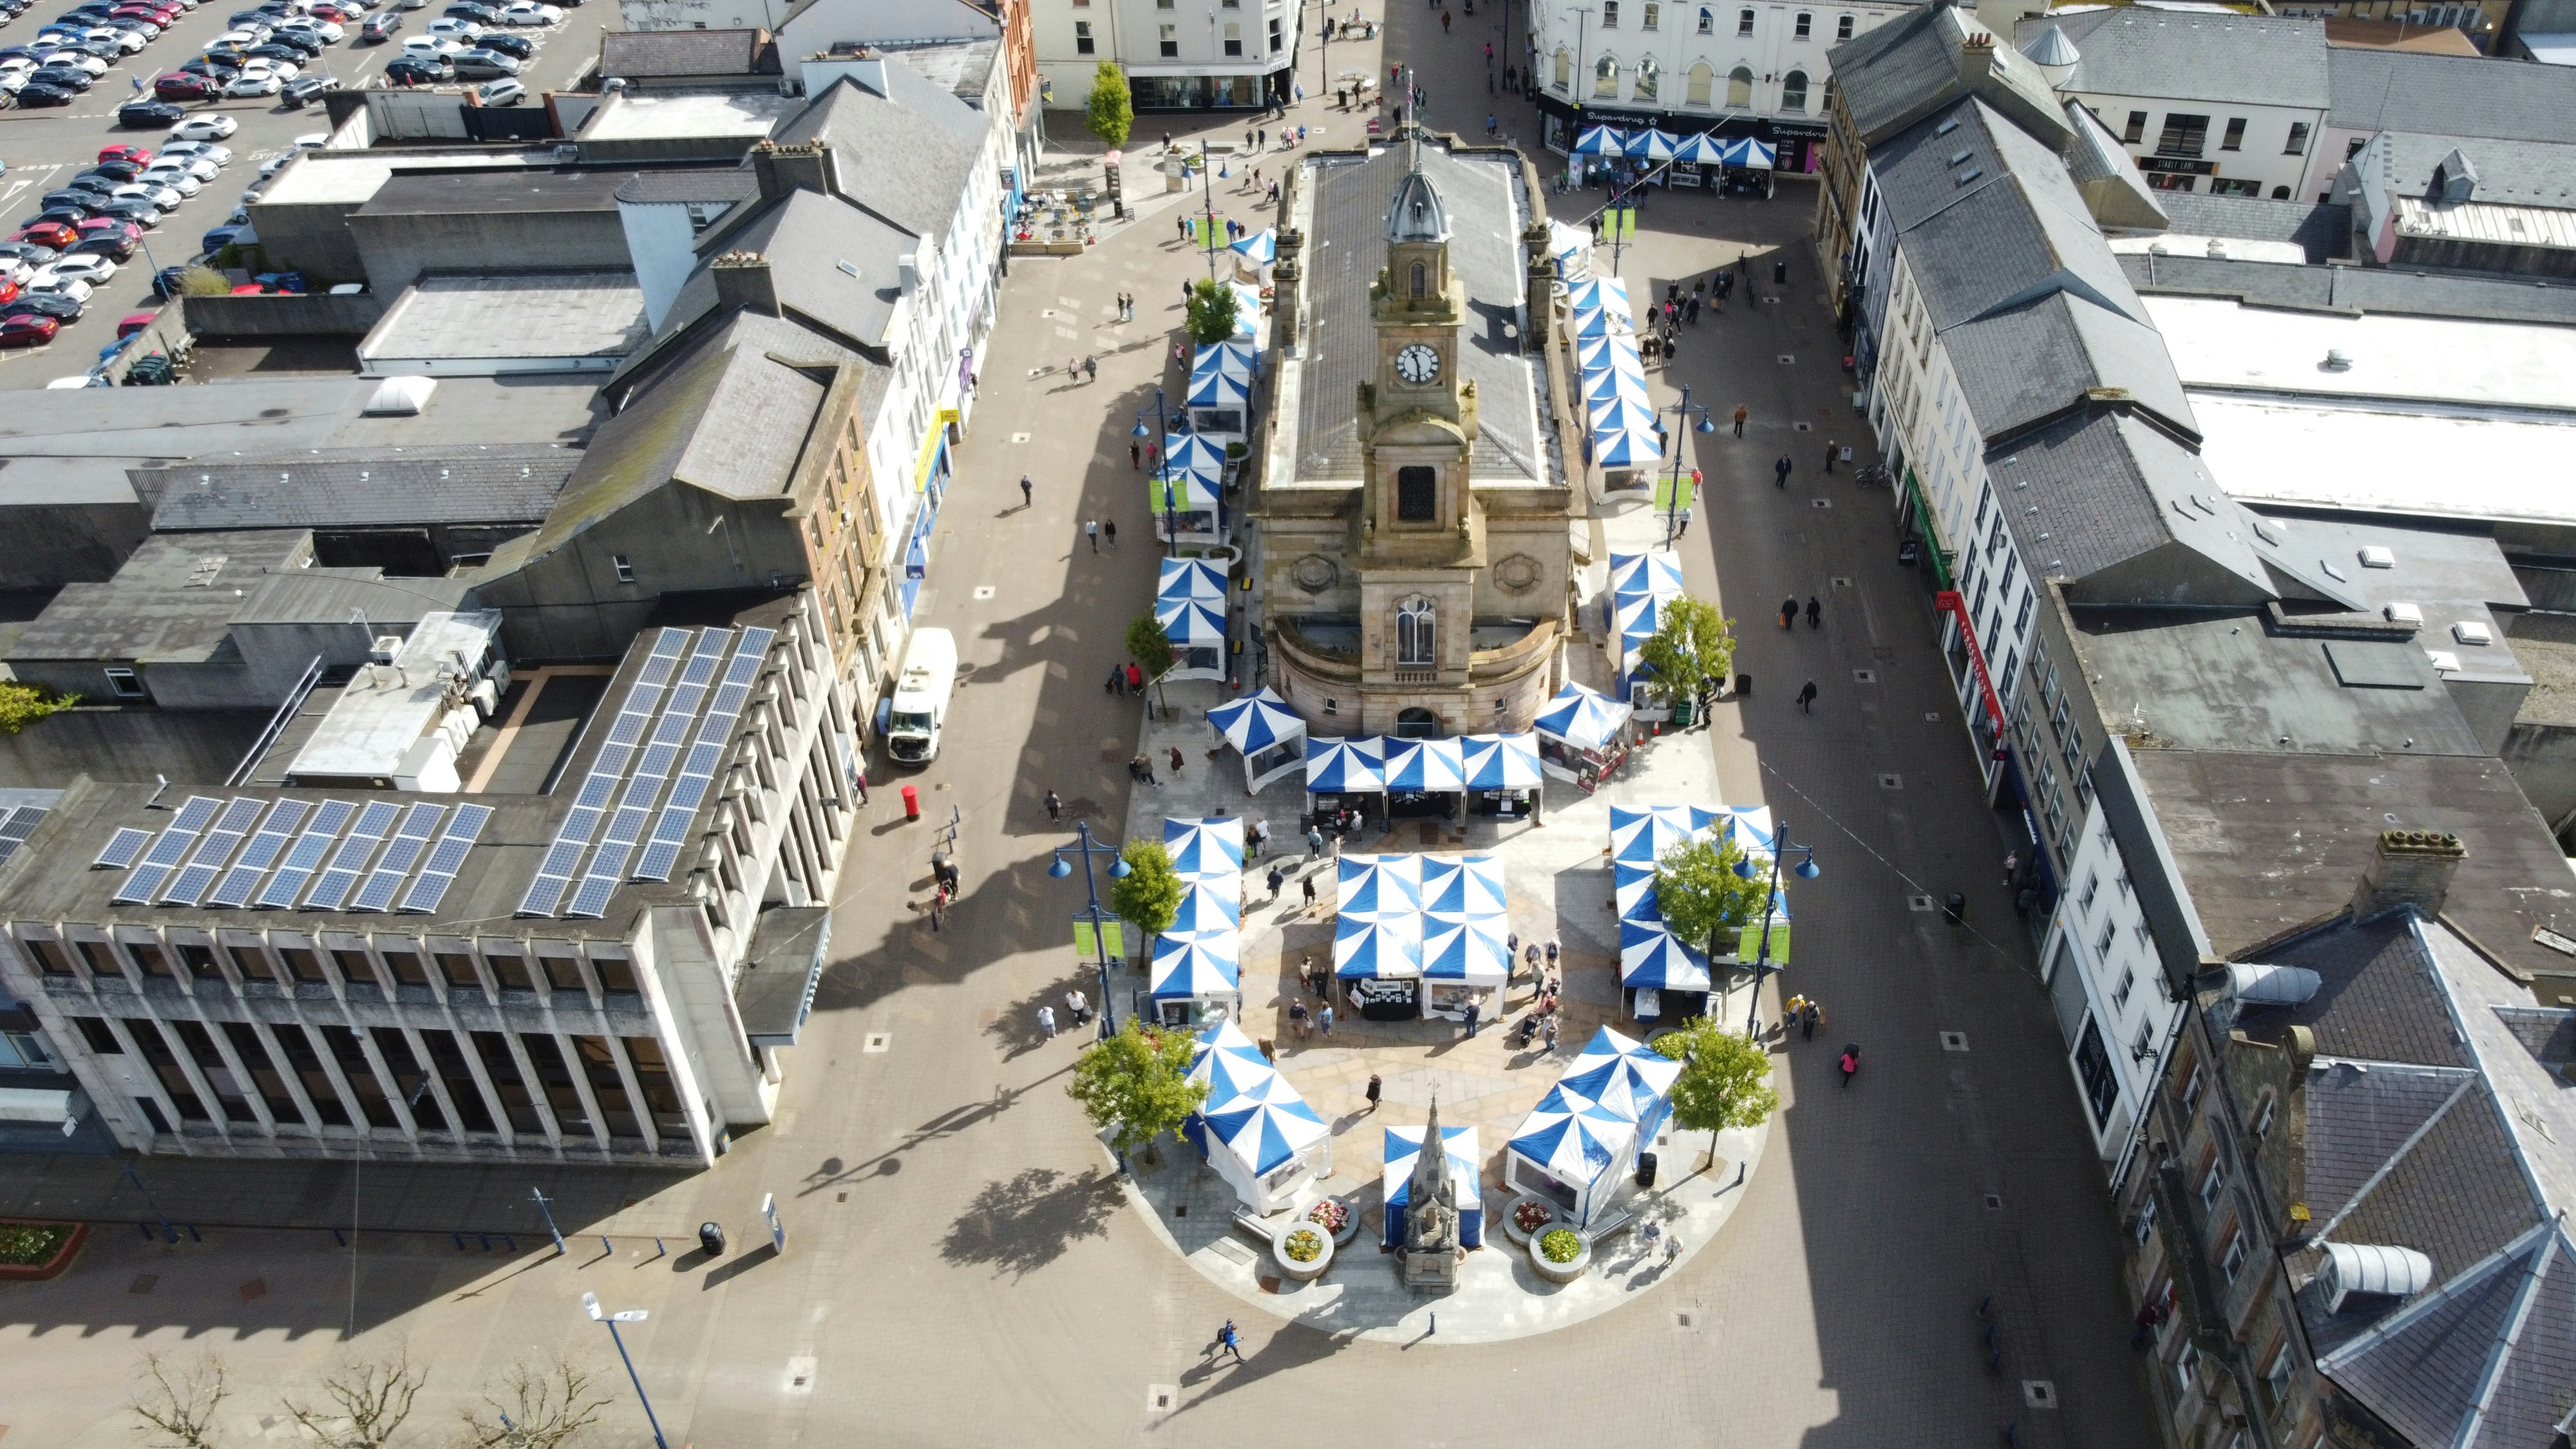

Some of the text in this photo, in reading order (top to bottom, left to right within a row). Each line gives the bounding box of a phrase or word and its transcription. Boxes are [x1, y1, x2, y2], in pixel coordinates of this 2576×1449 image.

[1587, 111, 1645, 126] Superdrug
[1772, 127, 1827, 137] Superdru
[2157, 160, 2195, 171] STABLE LANE
